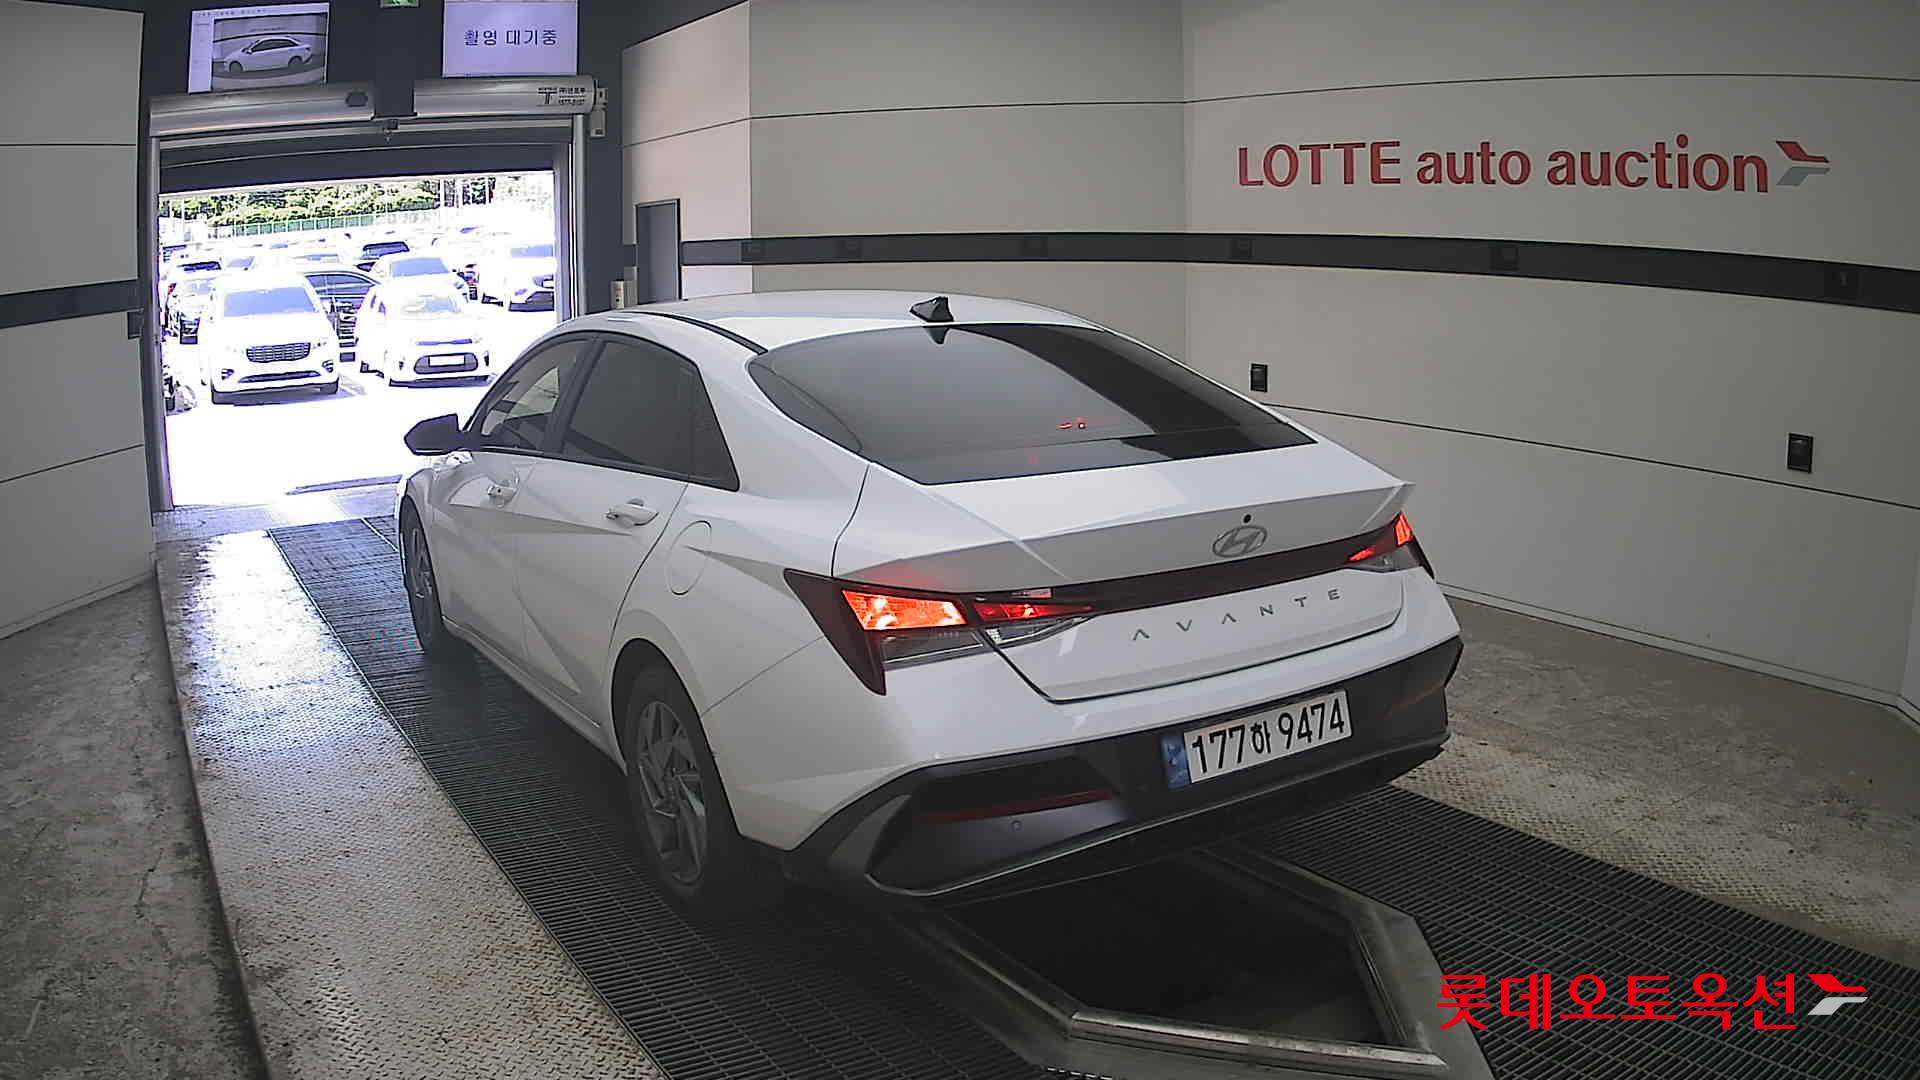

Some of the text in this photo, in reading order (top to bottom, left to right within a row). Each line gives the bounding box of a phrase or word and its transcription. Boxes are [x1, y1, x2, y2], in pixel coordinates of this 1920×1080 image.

[506, 29, 558, 46] 대기중
[1238, 134, 1768, 193] LOTTE auto auction
[1132, 589, 1341, 641] AVANTE
[1192, 699, 1345, 774] 177하 9474
